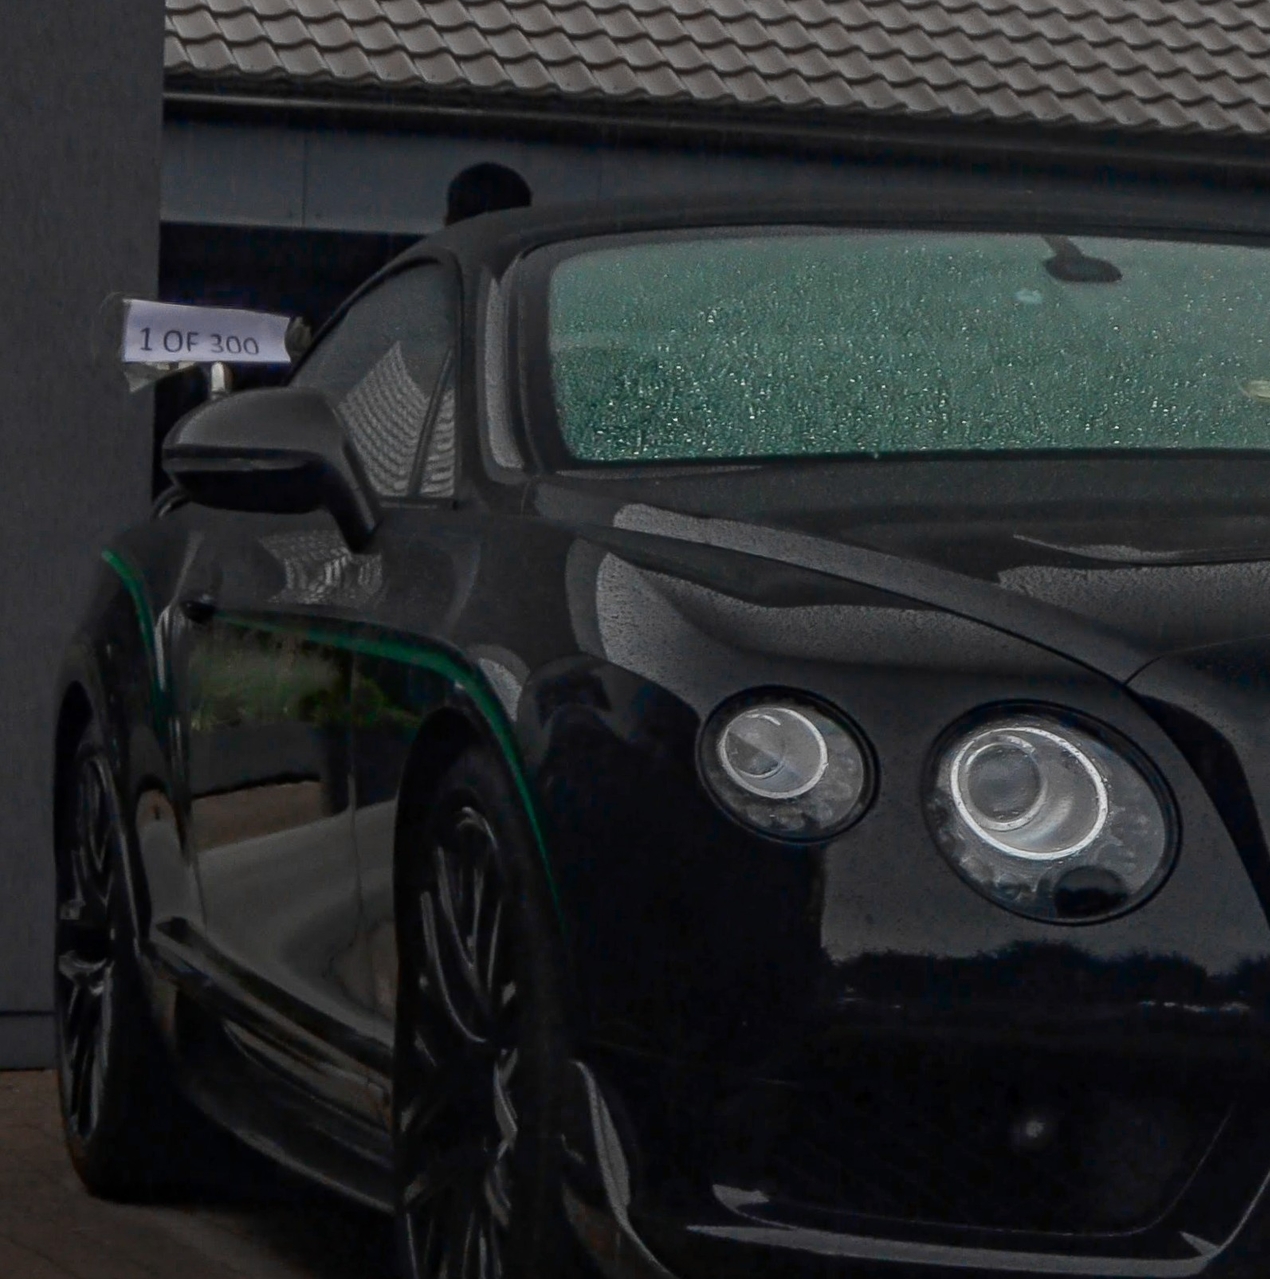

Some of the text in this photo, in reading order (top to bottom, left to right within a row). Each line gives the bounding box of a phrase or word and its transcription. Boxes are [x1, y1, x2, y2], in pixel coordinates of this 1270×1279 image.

[139, 327, 259, 355] 1 OF 300
